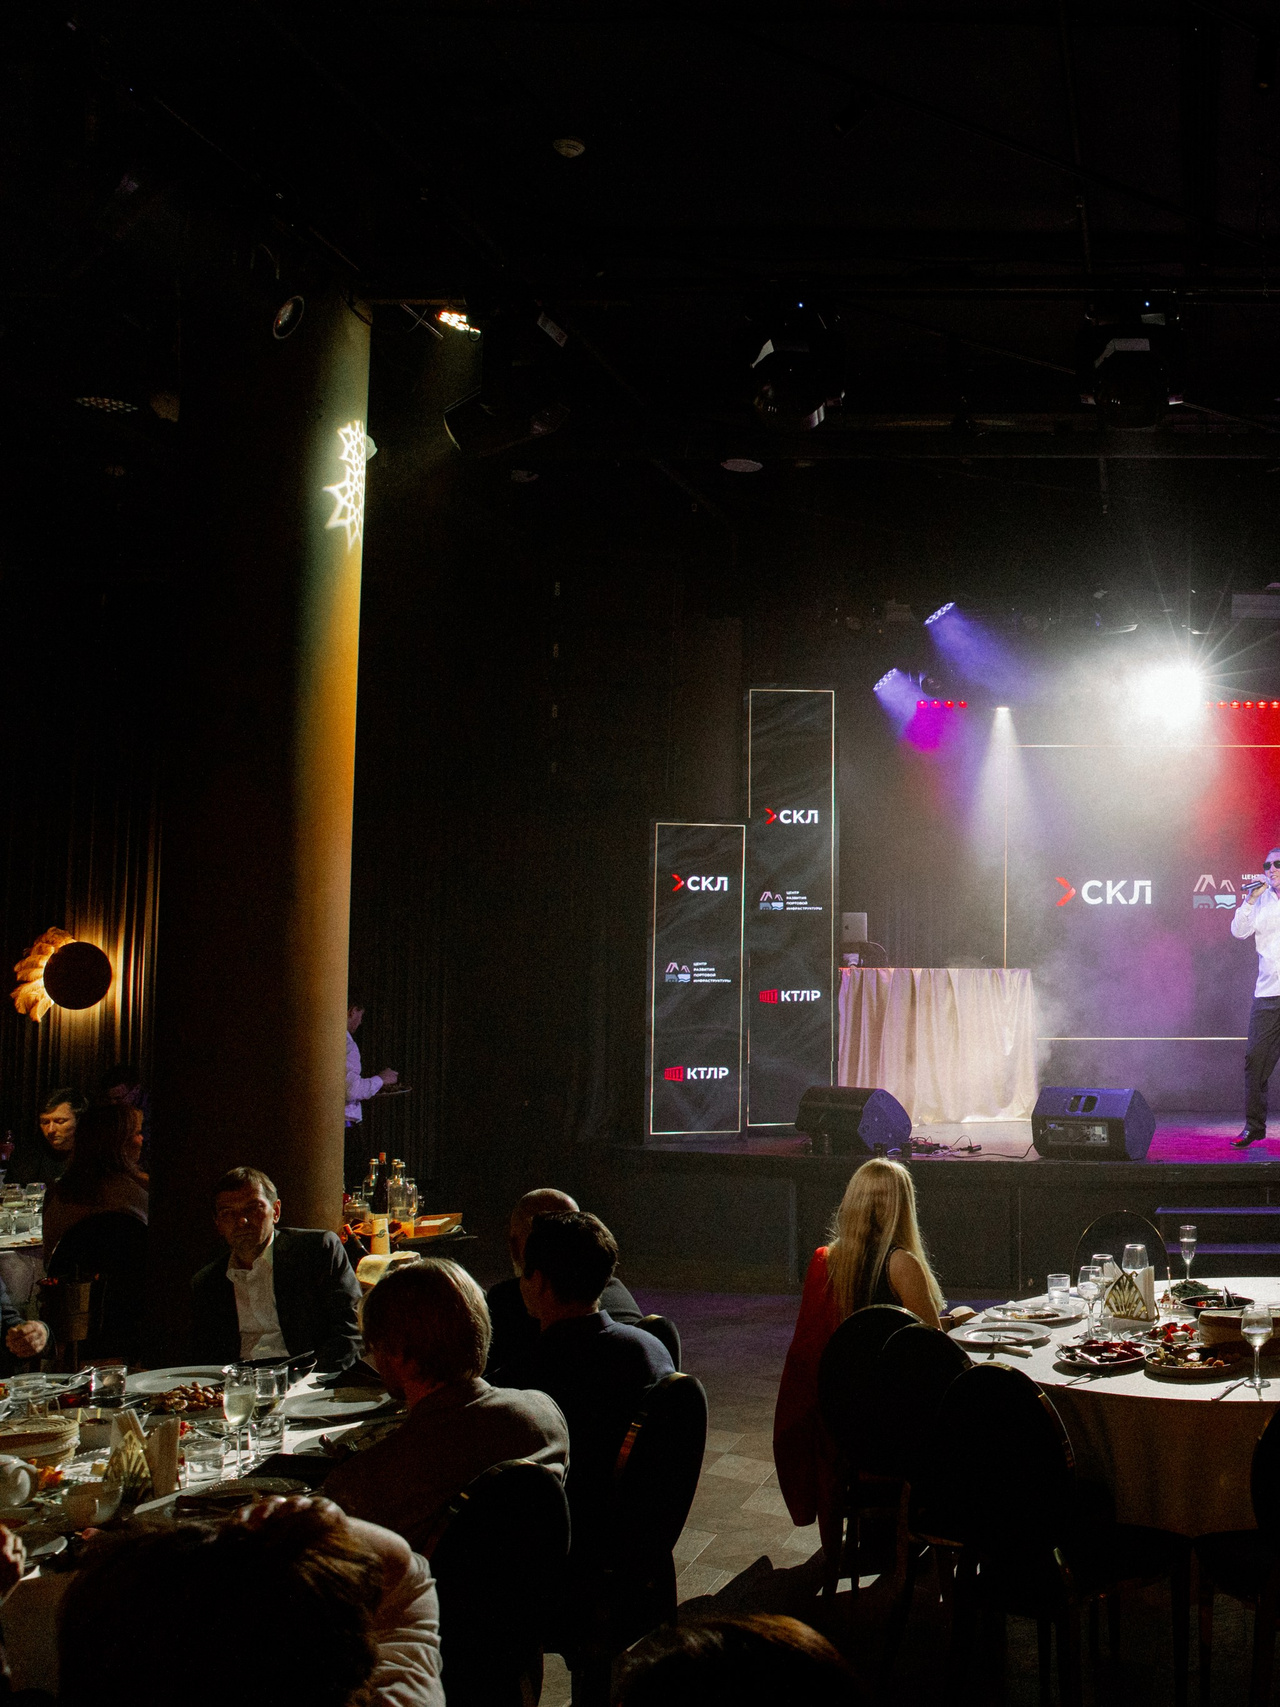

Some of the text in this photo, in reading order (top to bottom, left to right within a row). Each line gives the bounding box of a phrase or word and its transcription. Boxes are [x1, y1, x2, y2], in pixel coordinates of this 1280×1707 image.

[779, 809, 819, 825] СКЛ
[687, 875, 729, 891] СКЛ
[1081, 879, 1152, 905] СКЛ
[780, 990, 822, 1002] КТЛР
[687, 1067, 730, 1080] КТЛР
